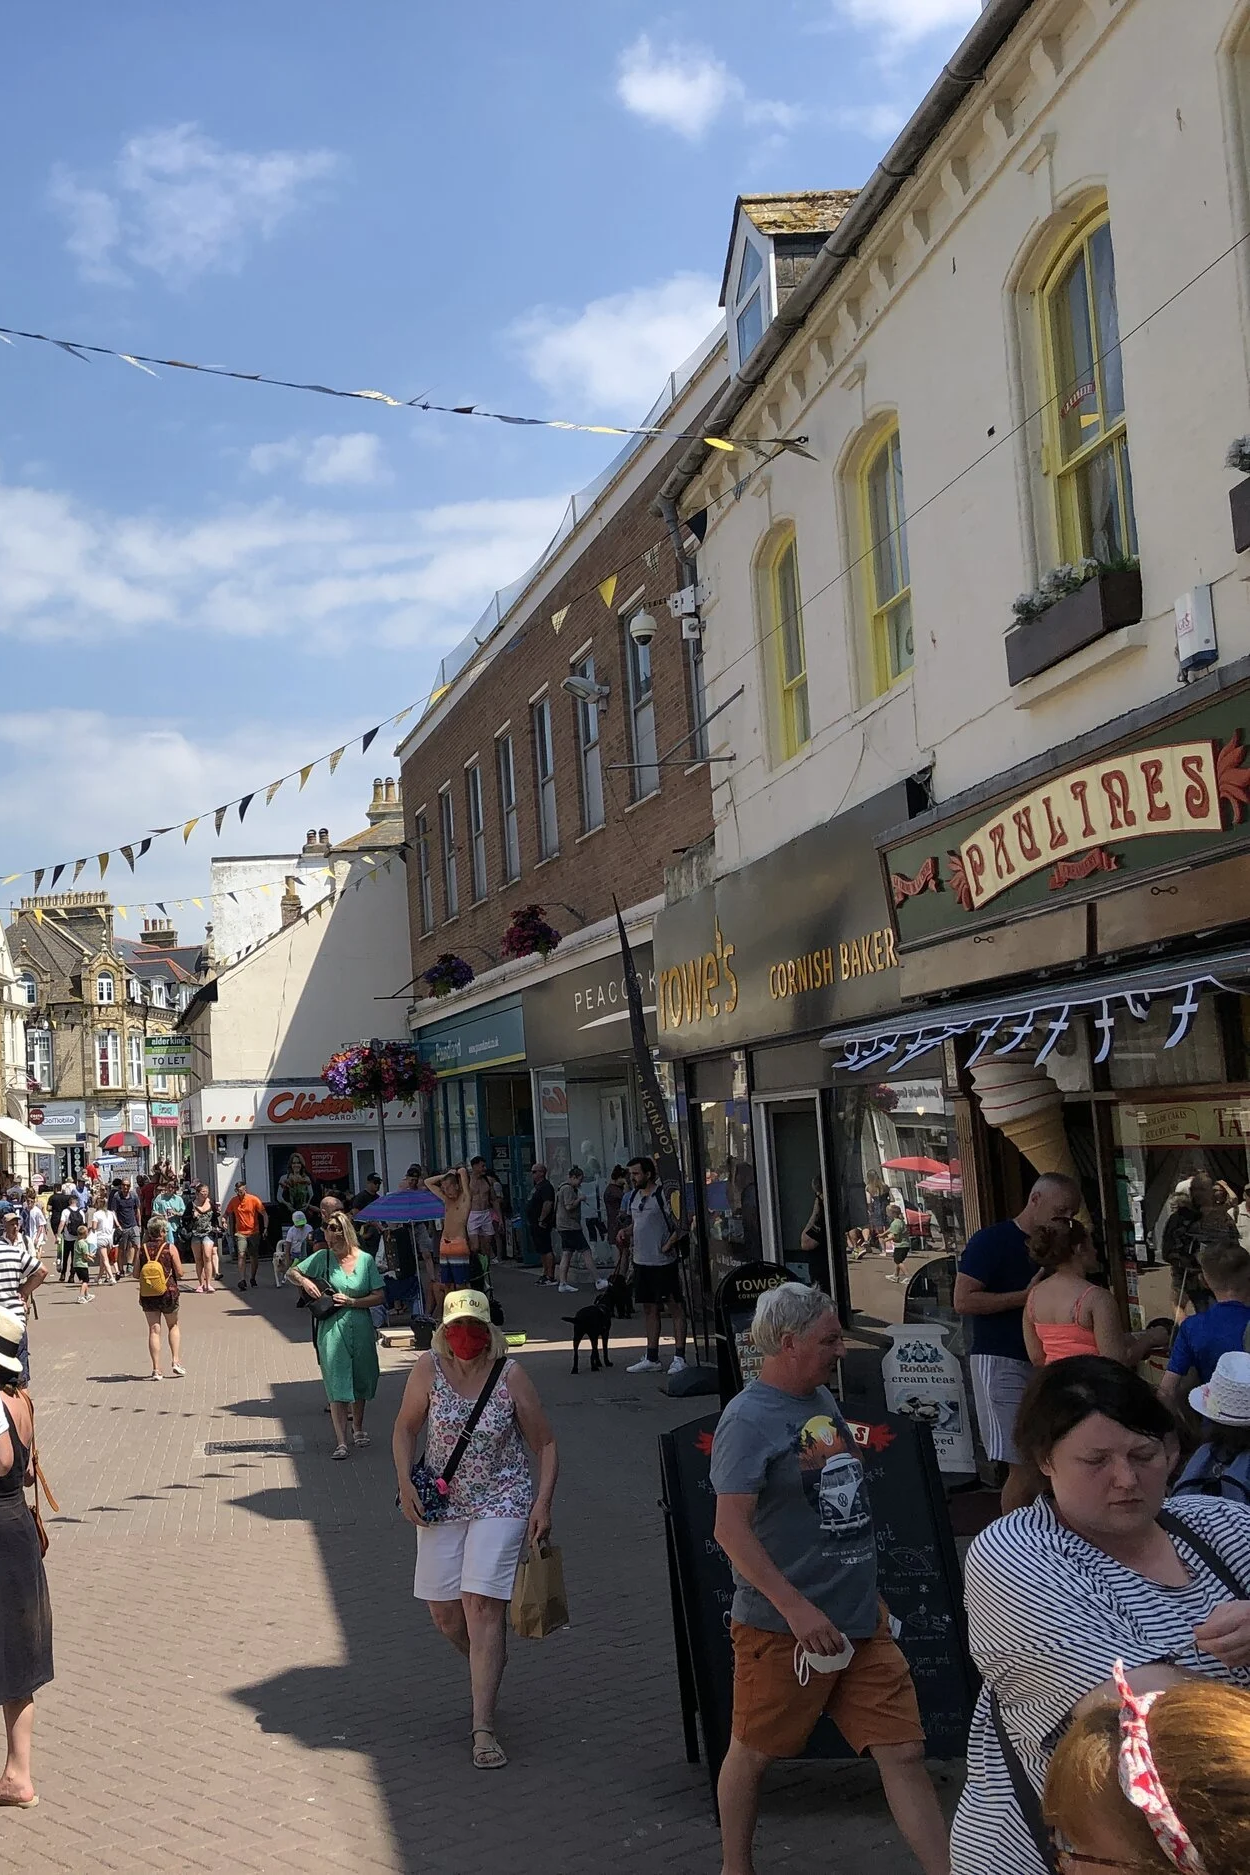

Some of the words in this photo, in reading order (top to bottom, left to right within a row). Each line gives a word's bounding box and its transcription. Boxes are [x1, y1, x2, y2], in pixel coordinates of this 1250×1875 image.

[966, 755, 1210, 897] PAULINES
[769, 947, 835, 1000] CORNISH
[839, 927, 898, 982] BAKER
[574, 973, 657, 1013] PEACOCK
[152, 1057, 165, 1065] TO
[168, 1056, 186, 1065] LET
[641, 1090, 673, 1154] CORNISH
[735, 1332, 753, 1343] BET
[740, 1357, 764, 1367] BETT
[899, 1363, 945, 1373] Rodda's
[890, 1376, 929, 1384] cream
[931, 1375, 956, 1384] teas
